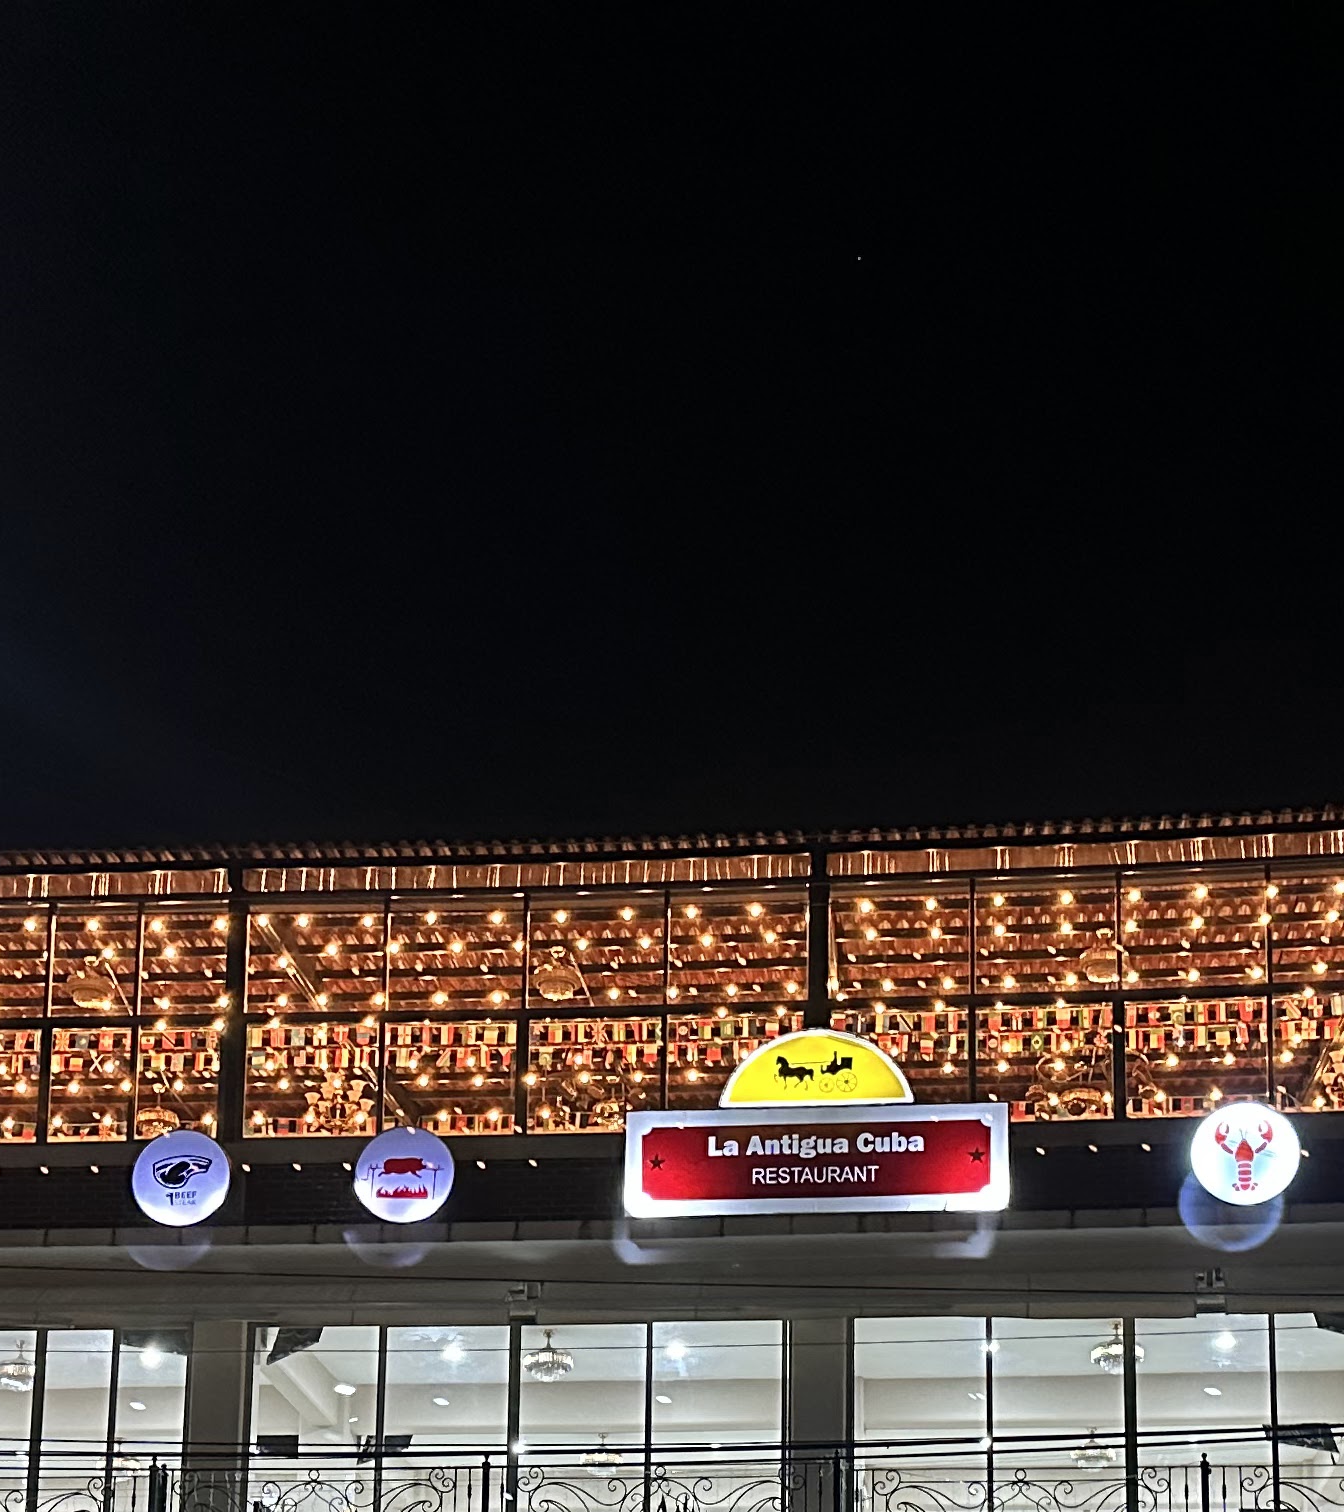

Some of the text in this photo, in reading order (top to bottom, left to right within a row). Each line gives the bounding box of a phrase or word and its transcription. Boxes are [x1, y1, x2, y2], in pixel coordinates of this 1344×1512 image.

[708, 1132, 925, 1158] La Antigua Cuba
[752, 1165, 879, 1185] RESTAURANT
